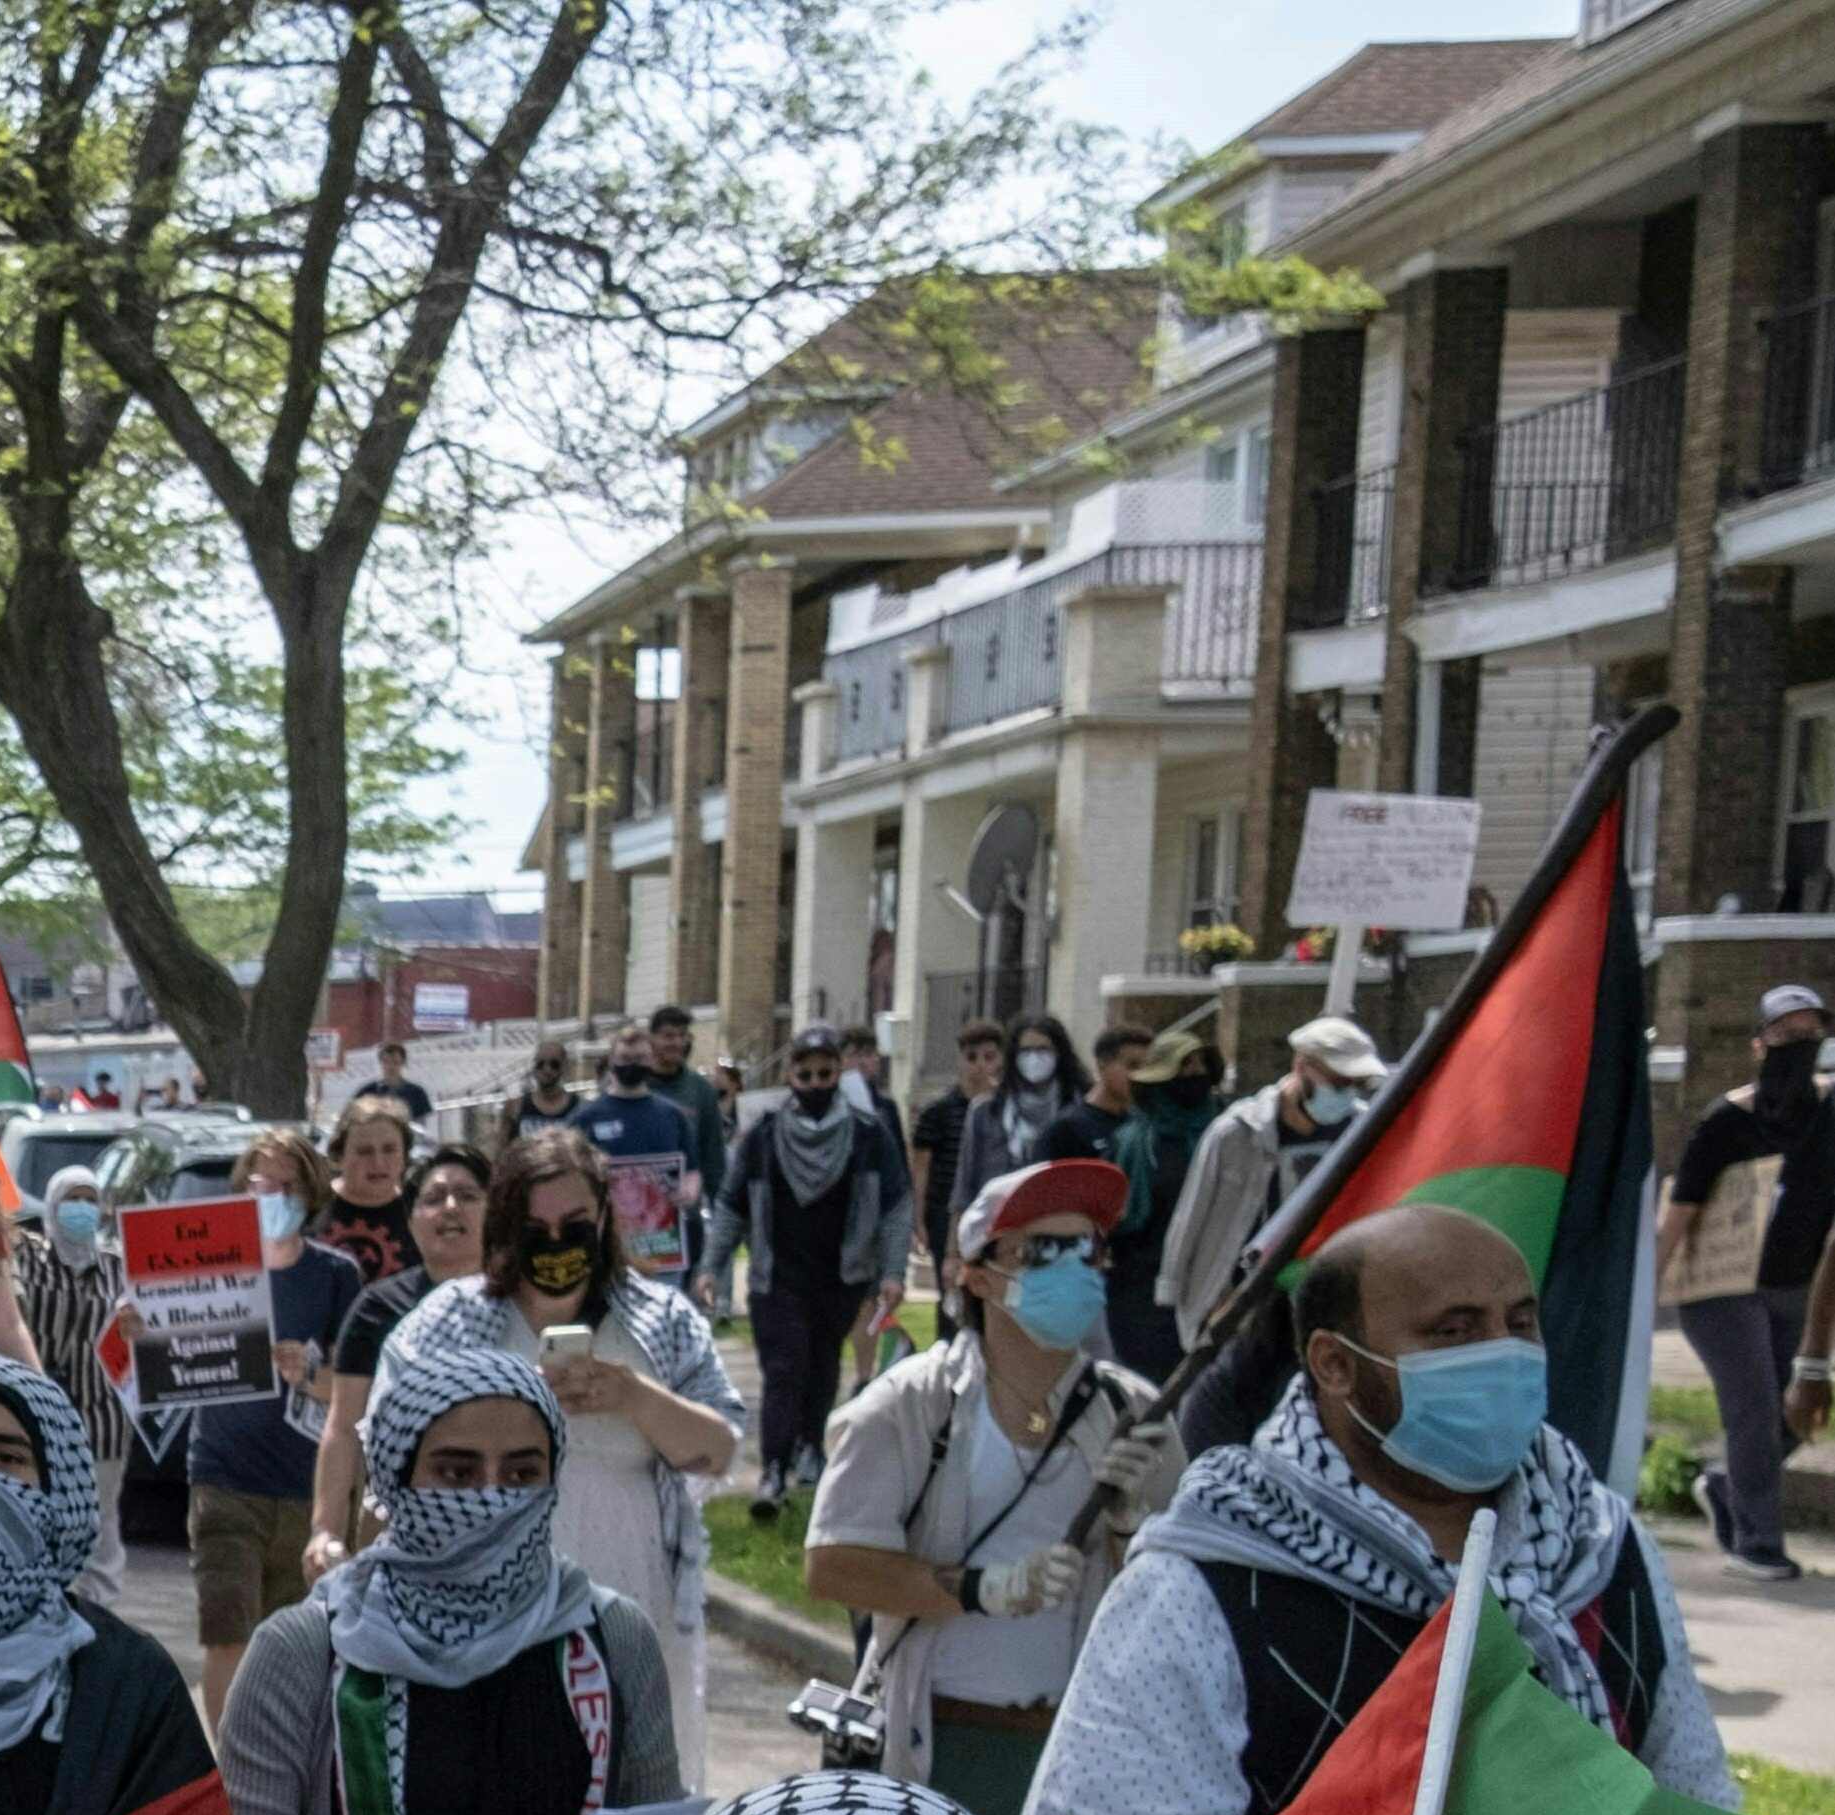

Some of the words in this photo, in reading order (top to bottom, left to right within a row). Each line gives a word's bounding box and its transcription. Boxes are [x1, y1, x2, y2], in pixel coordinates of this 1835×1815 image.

[176, 1222, 209, 1241] End
[195, 1247, 243, 1267] Saudi
[135, 1275, 218, 1299] Genocidal
[223, 1273, 257, 1291] War
[168, 1302, 252, 1326] Blockade
[168, 1330, 237, 1360] Against
